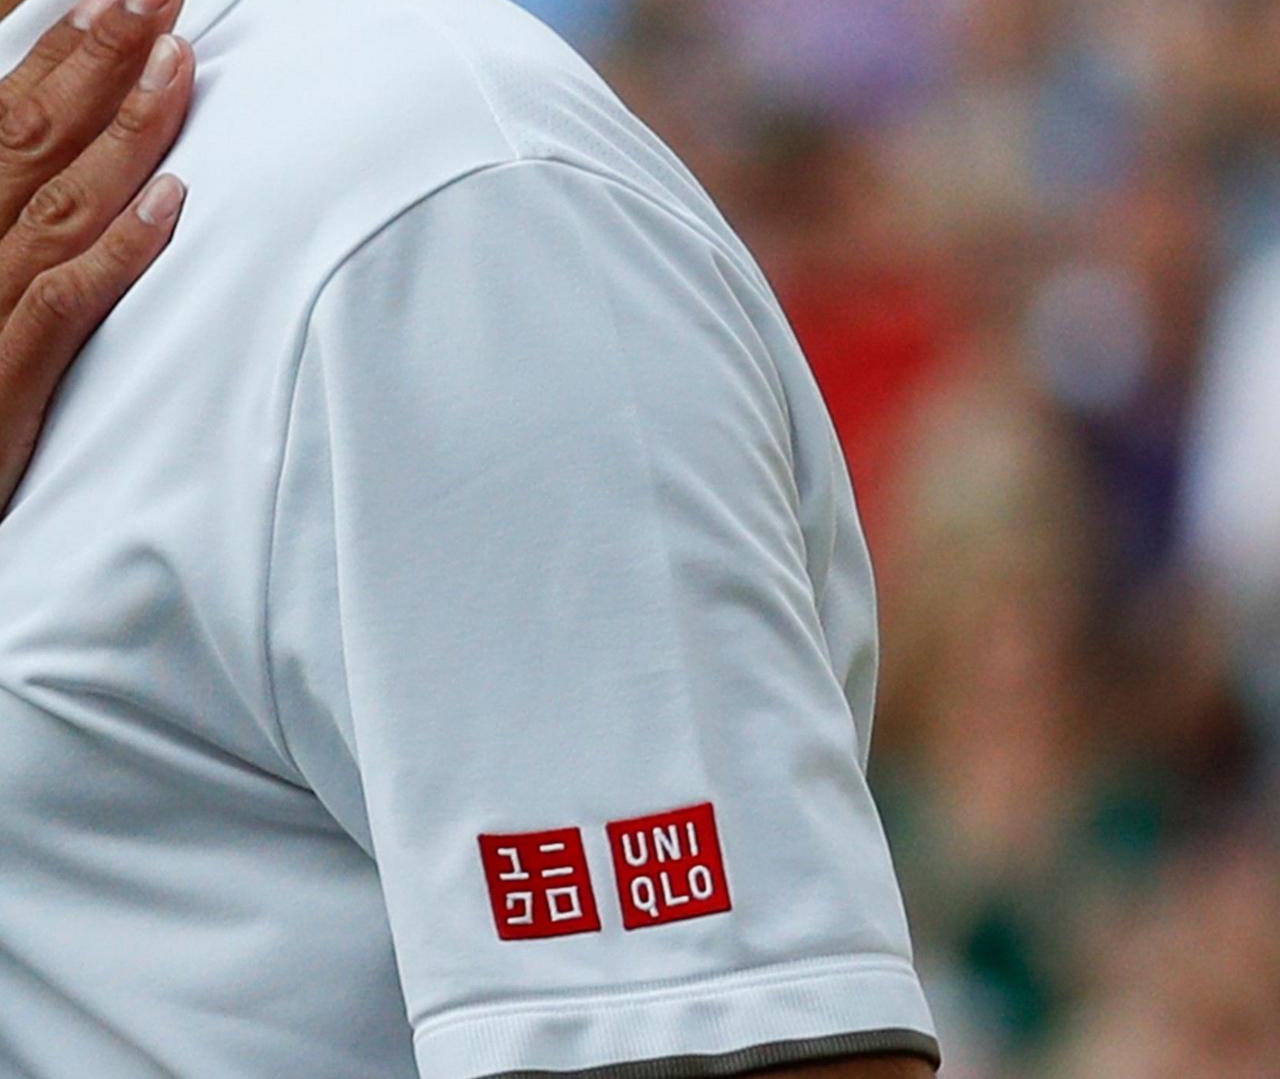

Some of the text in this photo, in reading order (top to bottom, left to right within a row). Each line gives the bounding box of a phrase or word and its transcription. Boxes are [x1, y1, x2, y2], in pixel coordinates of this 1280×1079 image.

[497, 842, 574, 881] ユニ
[621, 821, 698, 866] UNI
[630, 865, 714, 917] QLO
